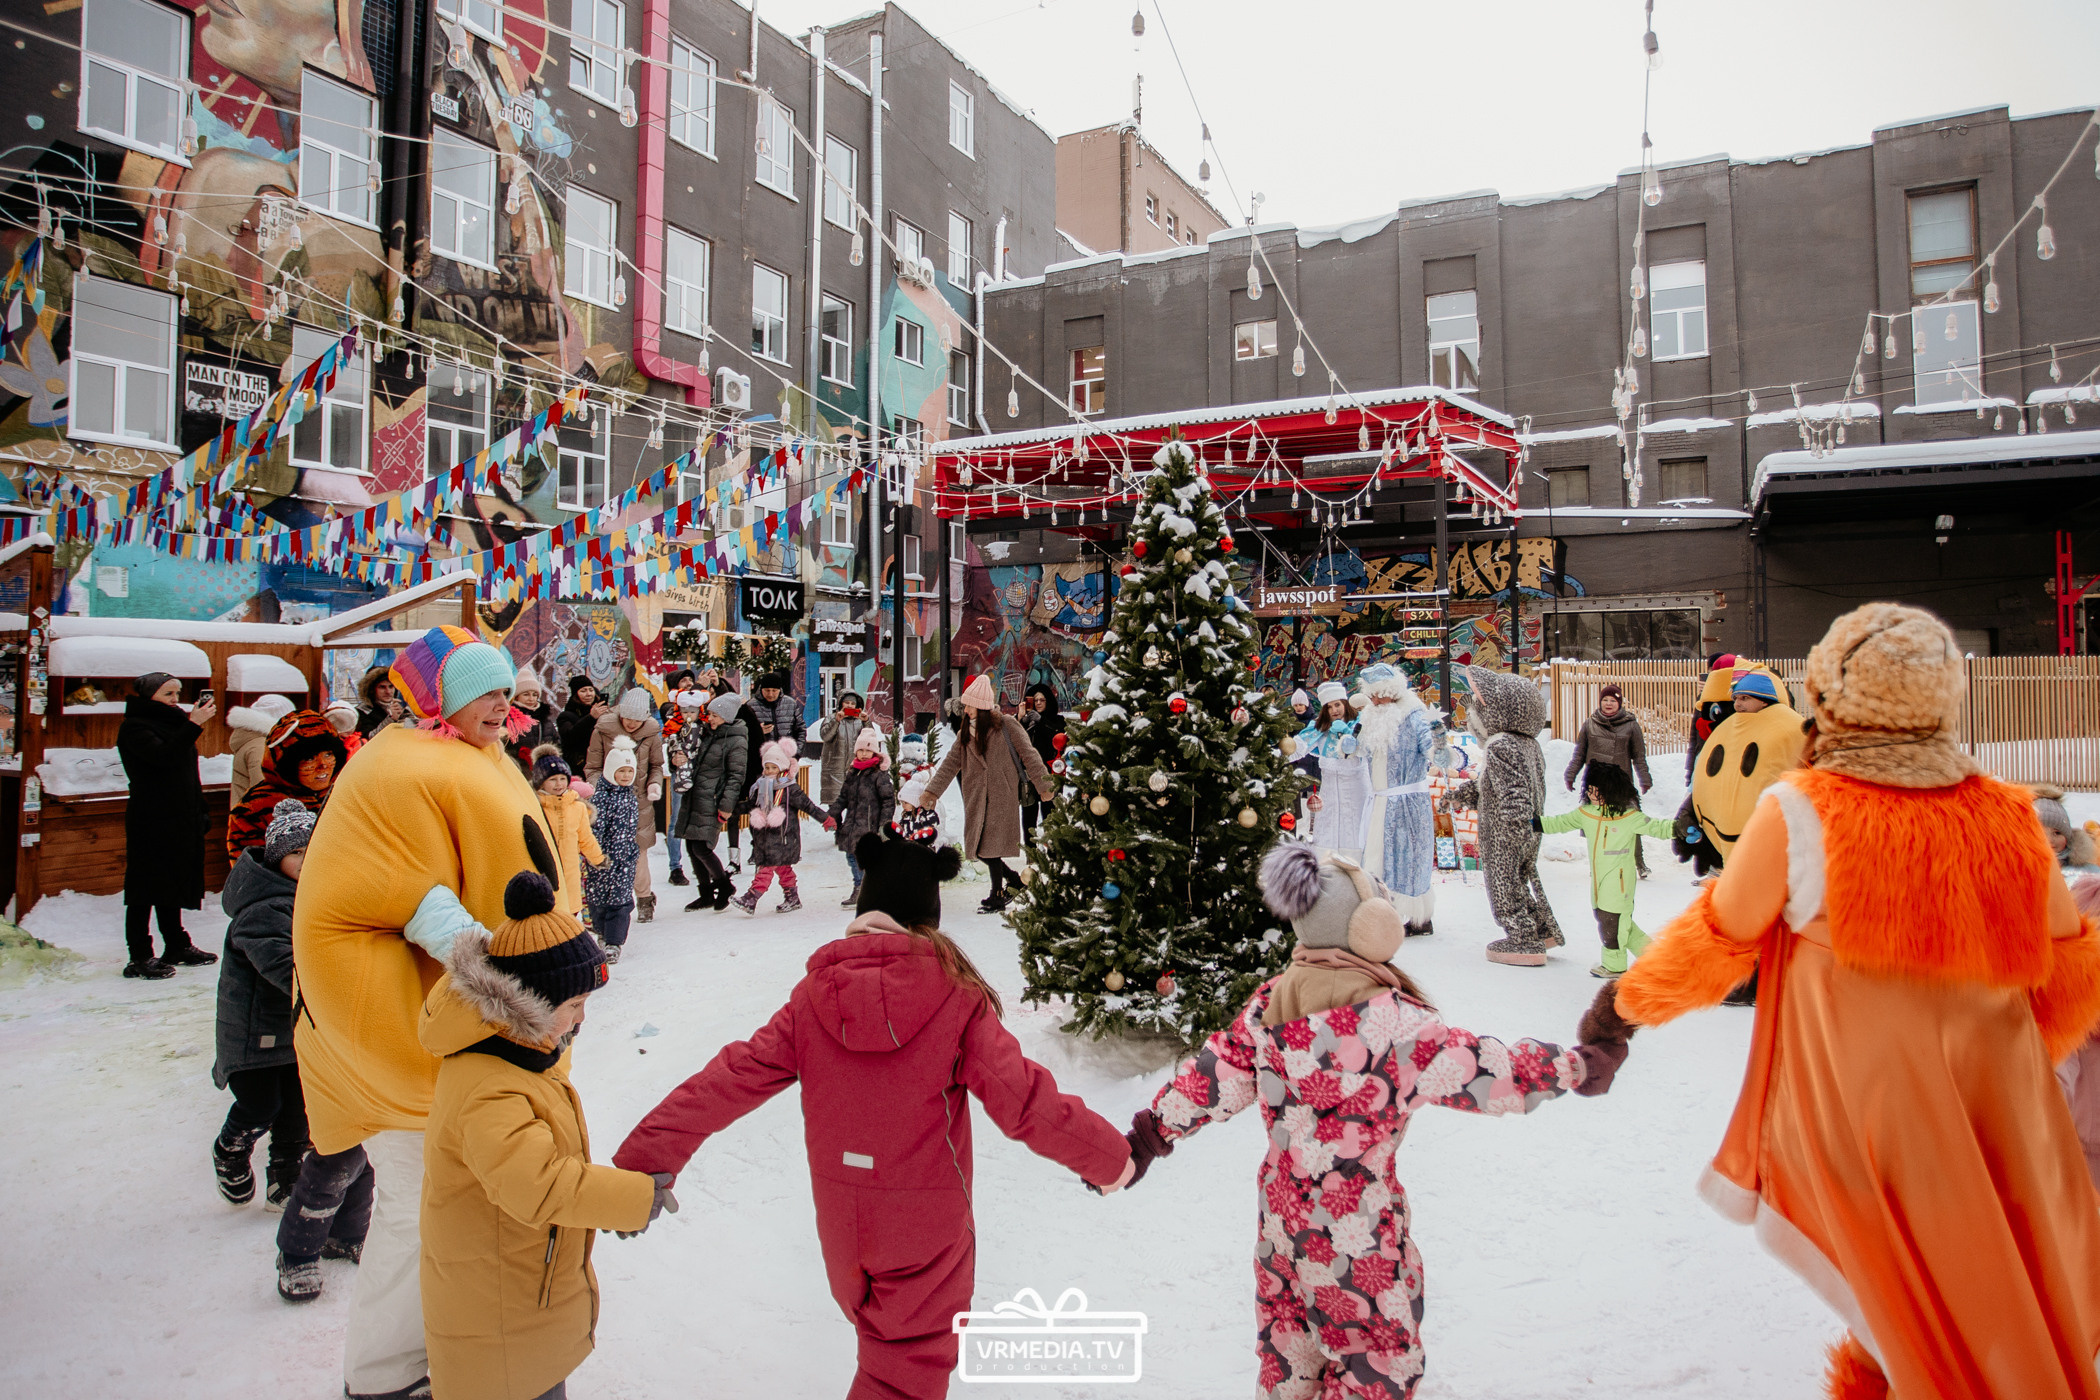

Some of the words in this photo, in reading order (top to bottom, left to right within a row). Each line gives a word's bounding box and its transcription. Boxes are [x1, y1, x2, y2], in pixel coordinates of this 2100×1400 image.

[431, 101, 458, 118] TUESDAY
[434, 94, 455, 110] BLACK
[457, 259, 529, 295] WEST
[188, 364, 219, 382] MAN
[223, 371, 241, 387] ON
[245, 375, 267, 391] THE
[229, 386, 266, 405] MOON
[665, 588, 686, 603] gives
[688, 594, 710, 611] birth
[1258, 586, 1337, 609] jawsspot
[1297, 605, 1316, 615] beach
[1410, 610, 1433, 620] S?X
[813, 618, 867, 636] jawsspot
[1409, 630, 1438, 639] CHILL
